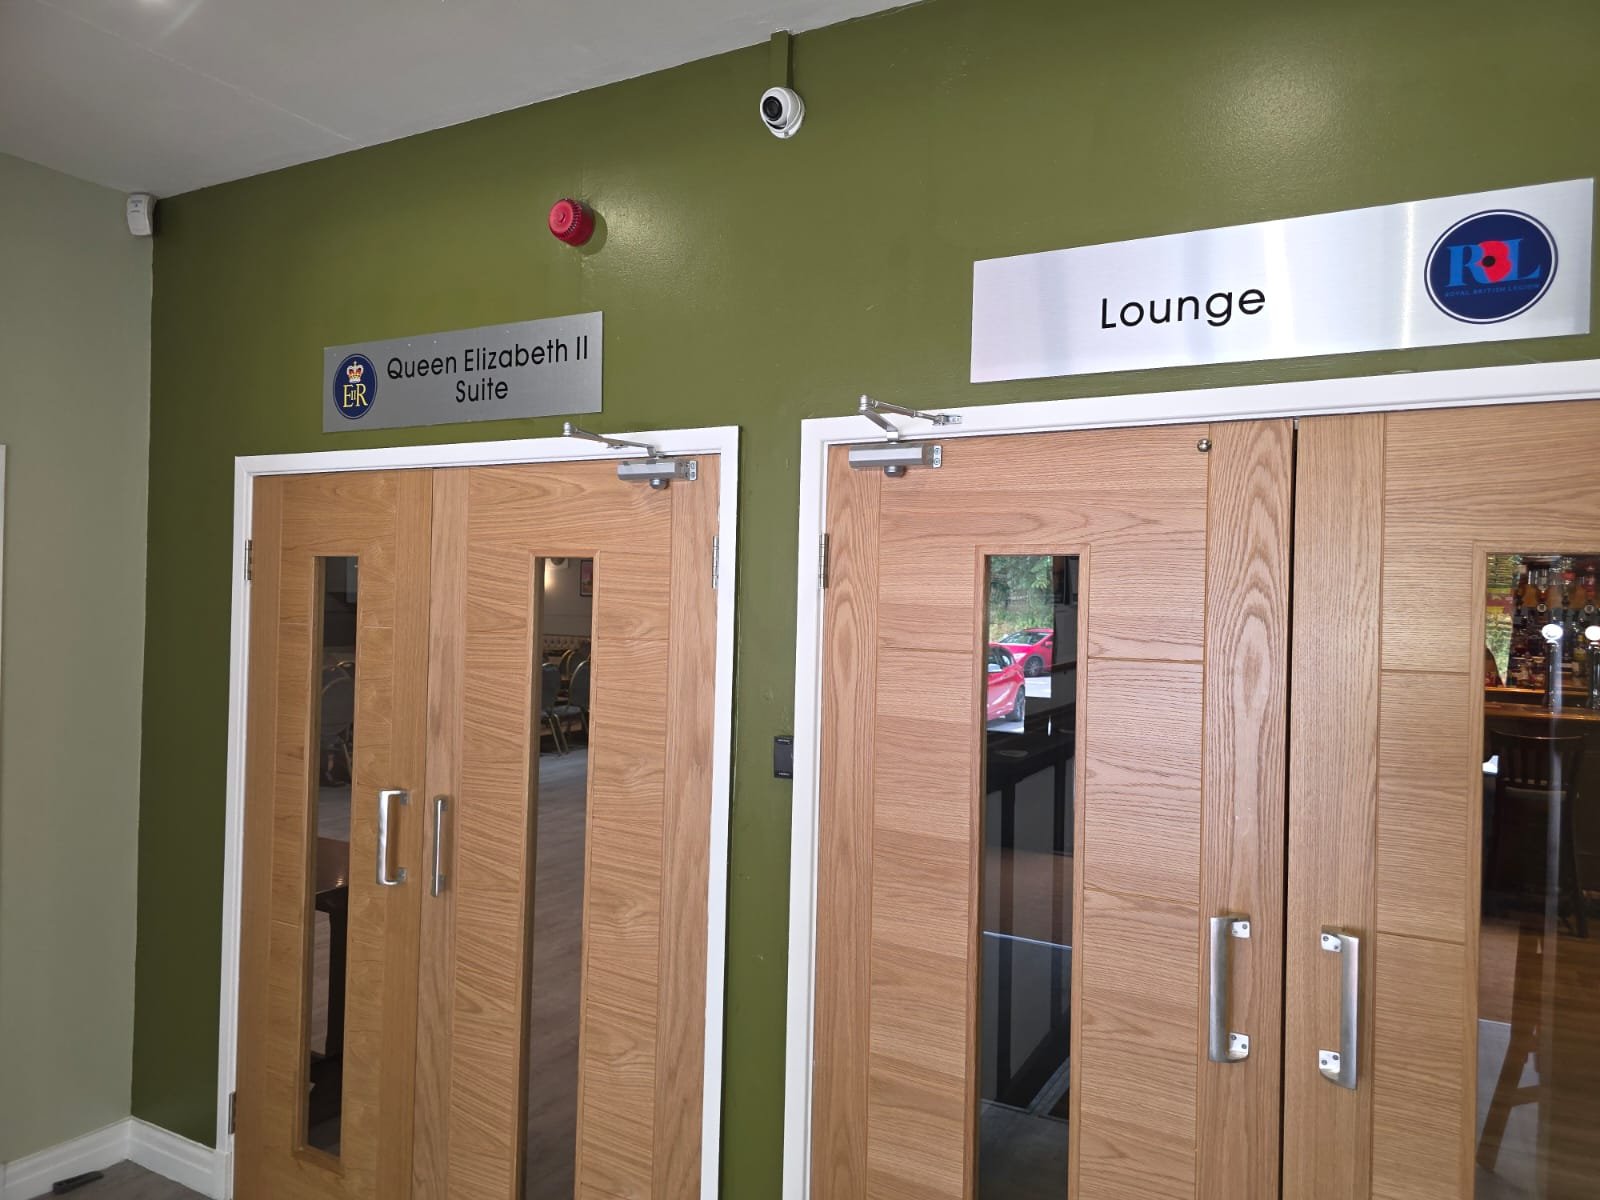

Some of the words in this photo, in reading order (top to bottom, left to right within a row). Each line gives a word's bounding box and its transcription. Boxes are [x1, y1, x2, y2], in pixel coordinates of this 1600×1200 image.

[1101, 288, 1266, 329] Lounge
[387, 356, 457, 380] Queen
[464, 339, 568, 372] Elizabeth
[576, 335, 588, 361] II
[455, 380, 509, 403] Suite
